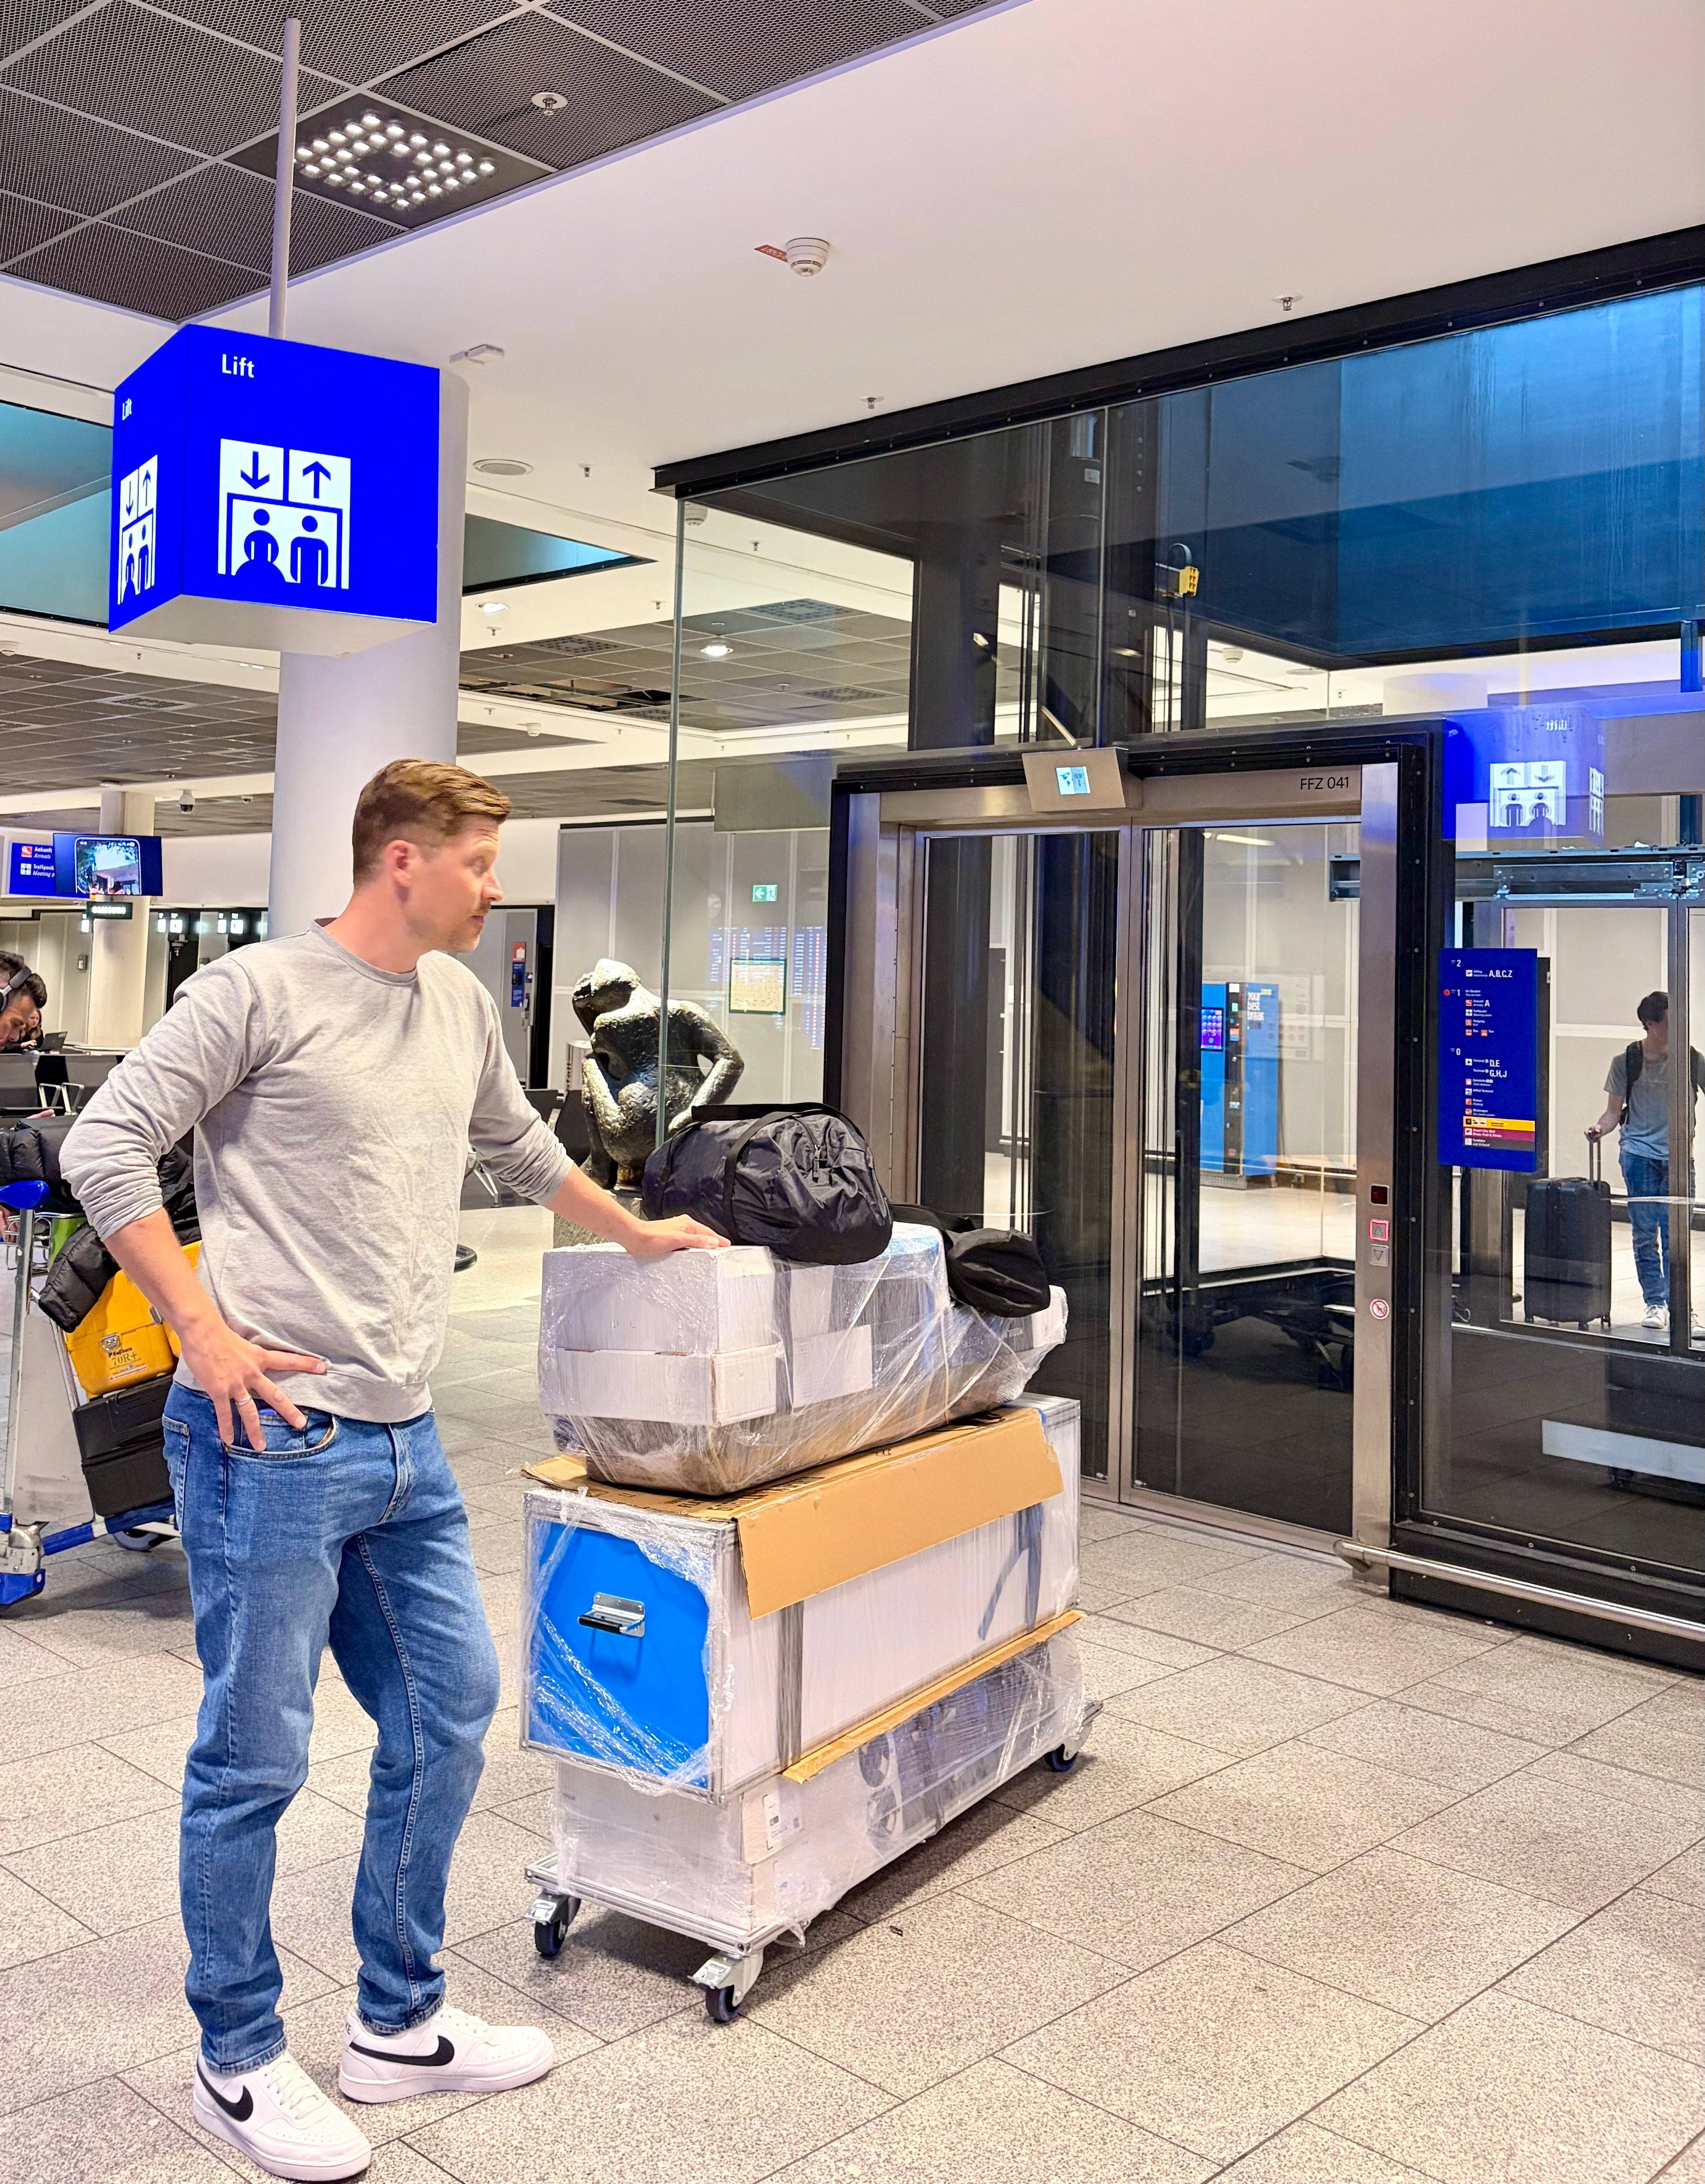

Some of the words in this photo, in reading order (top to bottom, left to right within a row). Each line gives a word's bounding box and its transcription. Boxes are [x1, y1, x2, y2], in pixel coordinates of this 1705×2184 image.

[222, 354, 255, 378] Lift
[122, 398, 133, 421] Lift
[1300, 778, 1324, 790] FFZ
[1327, 777, 1349, 789] 041
